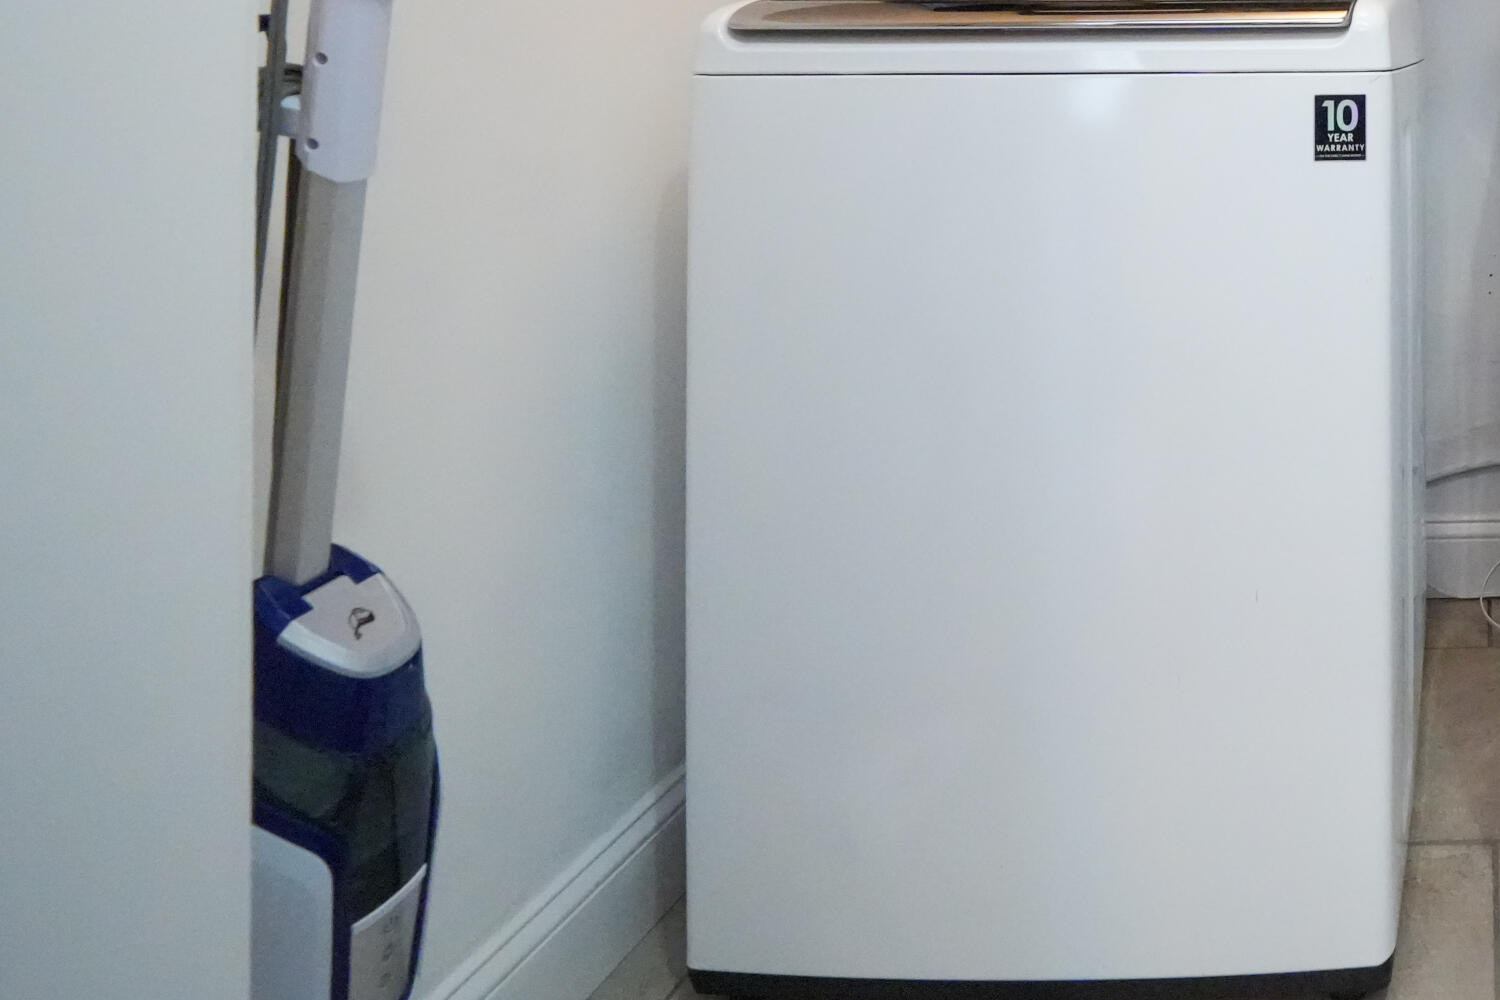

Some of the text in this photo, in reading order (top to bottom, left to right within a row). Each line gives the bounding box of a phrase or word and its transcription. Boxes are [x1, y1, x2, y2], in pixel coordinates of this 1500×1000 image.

[1321, 99, 1359, 132] 10
[1327, 133, 1354, 142] YEAR
[1316, 144, 1365, 152] WARRANTY
